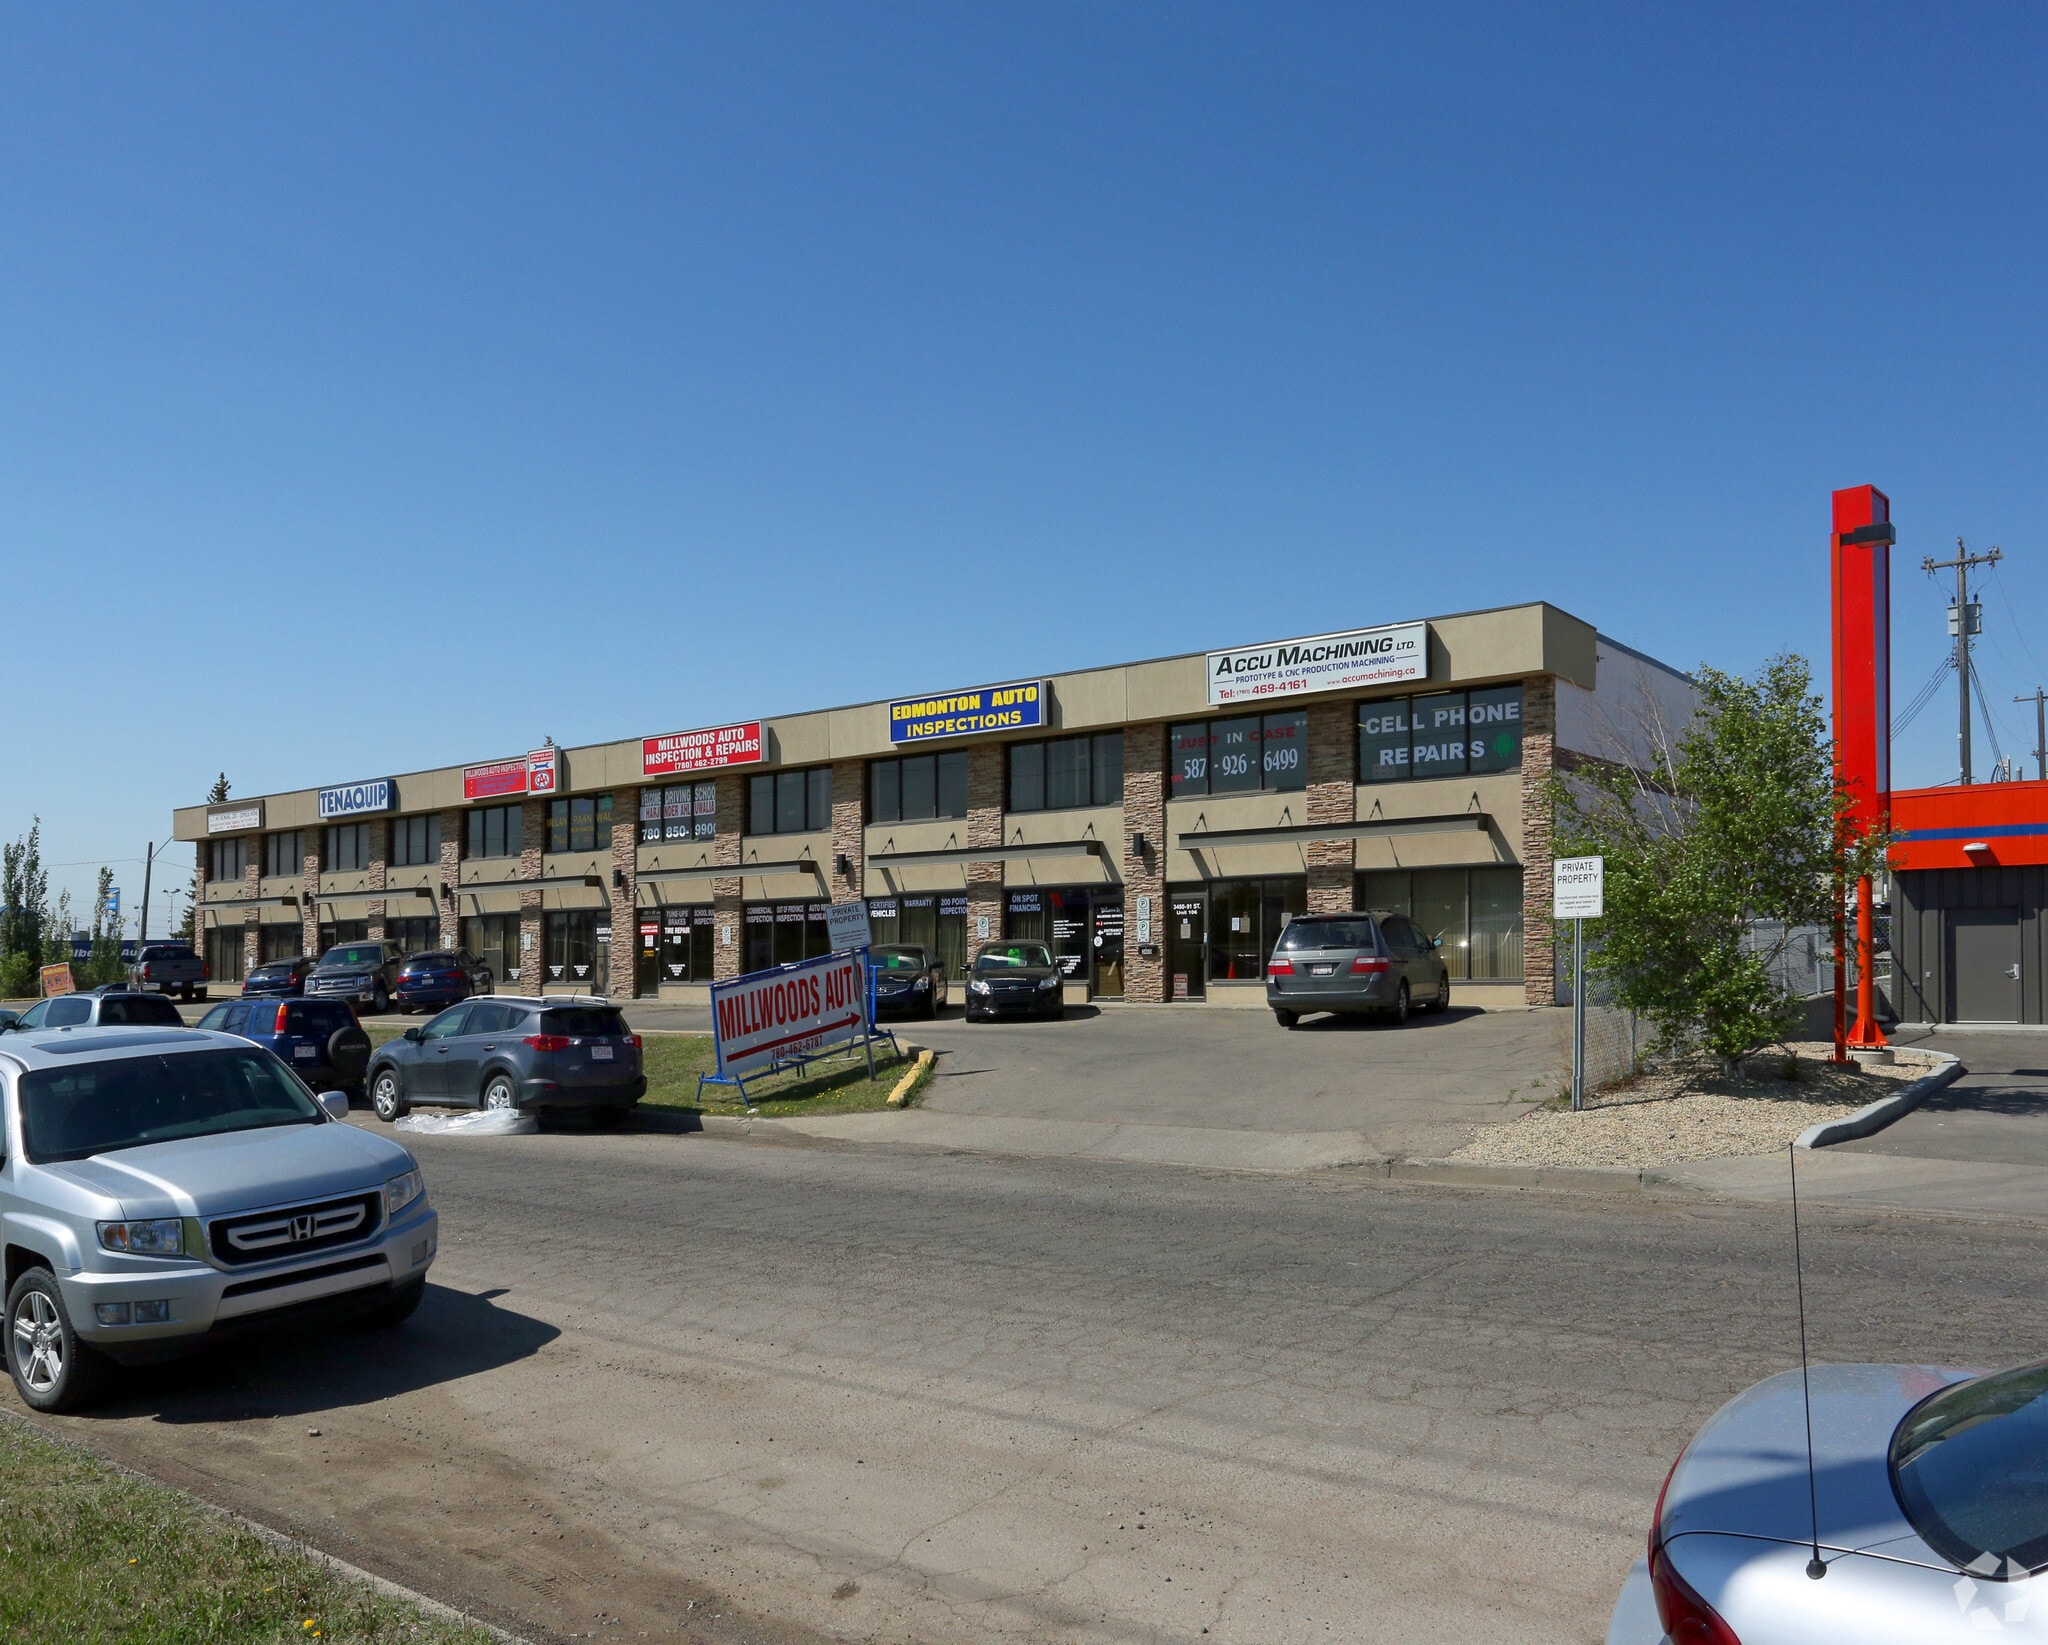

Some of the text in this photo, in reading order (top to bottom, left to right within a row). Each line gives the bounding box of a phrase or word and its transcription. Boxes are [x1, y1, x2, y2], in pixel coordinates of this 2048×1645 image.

[1216, 637, 1416, 676] ACCU MACHINING LTD.
[1235, 671, 1276, 684] PROTOTYPE
[1285, 668, 1300, 677] CNC
[1301, 661, 1350, 675] PRODUCTION
[1351, 655, 1395, 668] MACHINING
[1218, 666, 1416, 699] Tel: (780) 469-4161 www.accumachining.ca
[892, 686, 1037, 721] EDMONTON AUTO
[906, 710, 1021, 737] INSPECTIONS
[1366, 702, 1519, 734] CELL PHONE
[658, 727, 745, 752] MILLWOODS AUTO
[1226, 732, 1243, 744] IN
[645, 739, 759, 765] INSPECTION & REPAIRS
[1380, 741, 1485, 766] REPAIRS
[674, 756, 728, 770] (780) 462-2799
[1184, 758, 1207, 779] 587
[1222, 753, 1247, 776] 926
[1263, 748, 1298, 772] 6499
[465, 769, 489, 778] MILLWOODS
[489, 765, 501, 775] AUTO
[320, 783, 387, 814] TENAQUIP
[665, 788, 691, 804] DRIVING
[695, 785, 715, 801] SCHOO
[641, 828, 660, 840] 780
[1561, 861, 1594, 872] PRIVATE
[1557, 873, 1599, 884] PROPERTY
[904, 898, 933, 908] WARRANTY
[940, 897, 968, 906] 200 POINT
[1011, 893, 1039, 902] ON SPOT
[746, 906, 773, 915] COMMERCIAL
[809, 904, 820, 912] AUTO
[832, 904, 860, 916] PRIVATE
[869, 900, 897, 909] CERTIFIED
[1009, 903, 1041, 913] FINANCING
[666, 910, 688, 918] TUNE-UPS
[870, 909, 897, 918] VEHICLES
[939, 906, 968, 916] INSPECTIO
[668, 918, 686, 926] BRAKES
[746, 915, 773, 923] INSPECTION
[776, 914, 804, 922] INSPECTION
[830, 913, 865, 925] PROPERTY
[718, 974, 821, 1042] MILLWOODS
[770, 1035, 823, 1060] 780-462-6787
